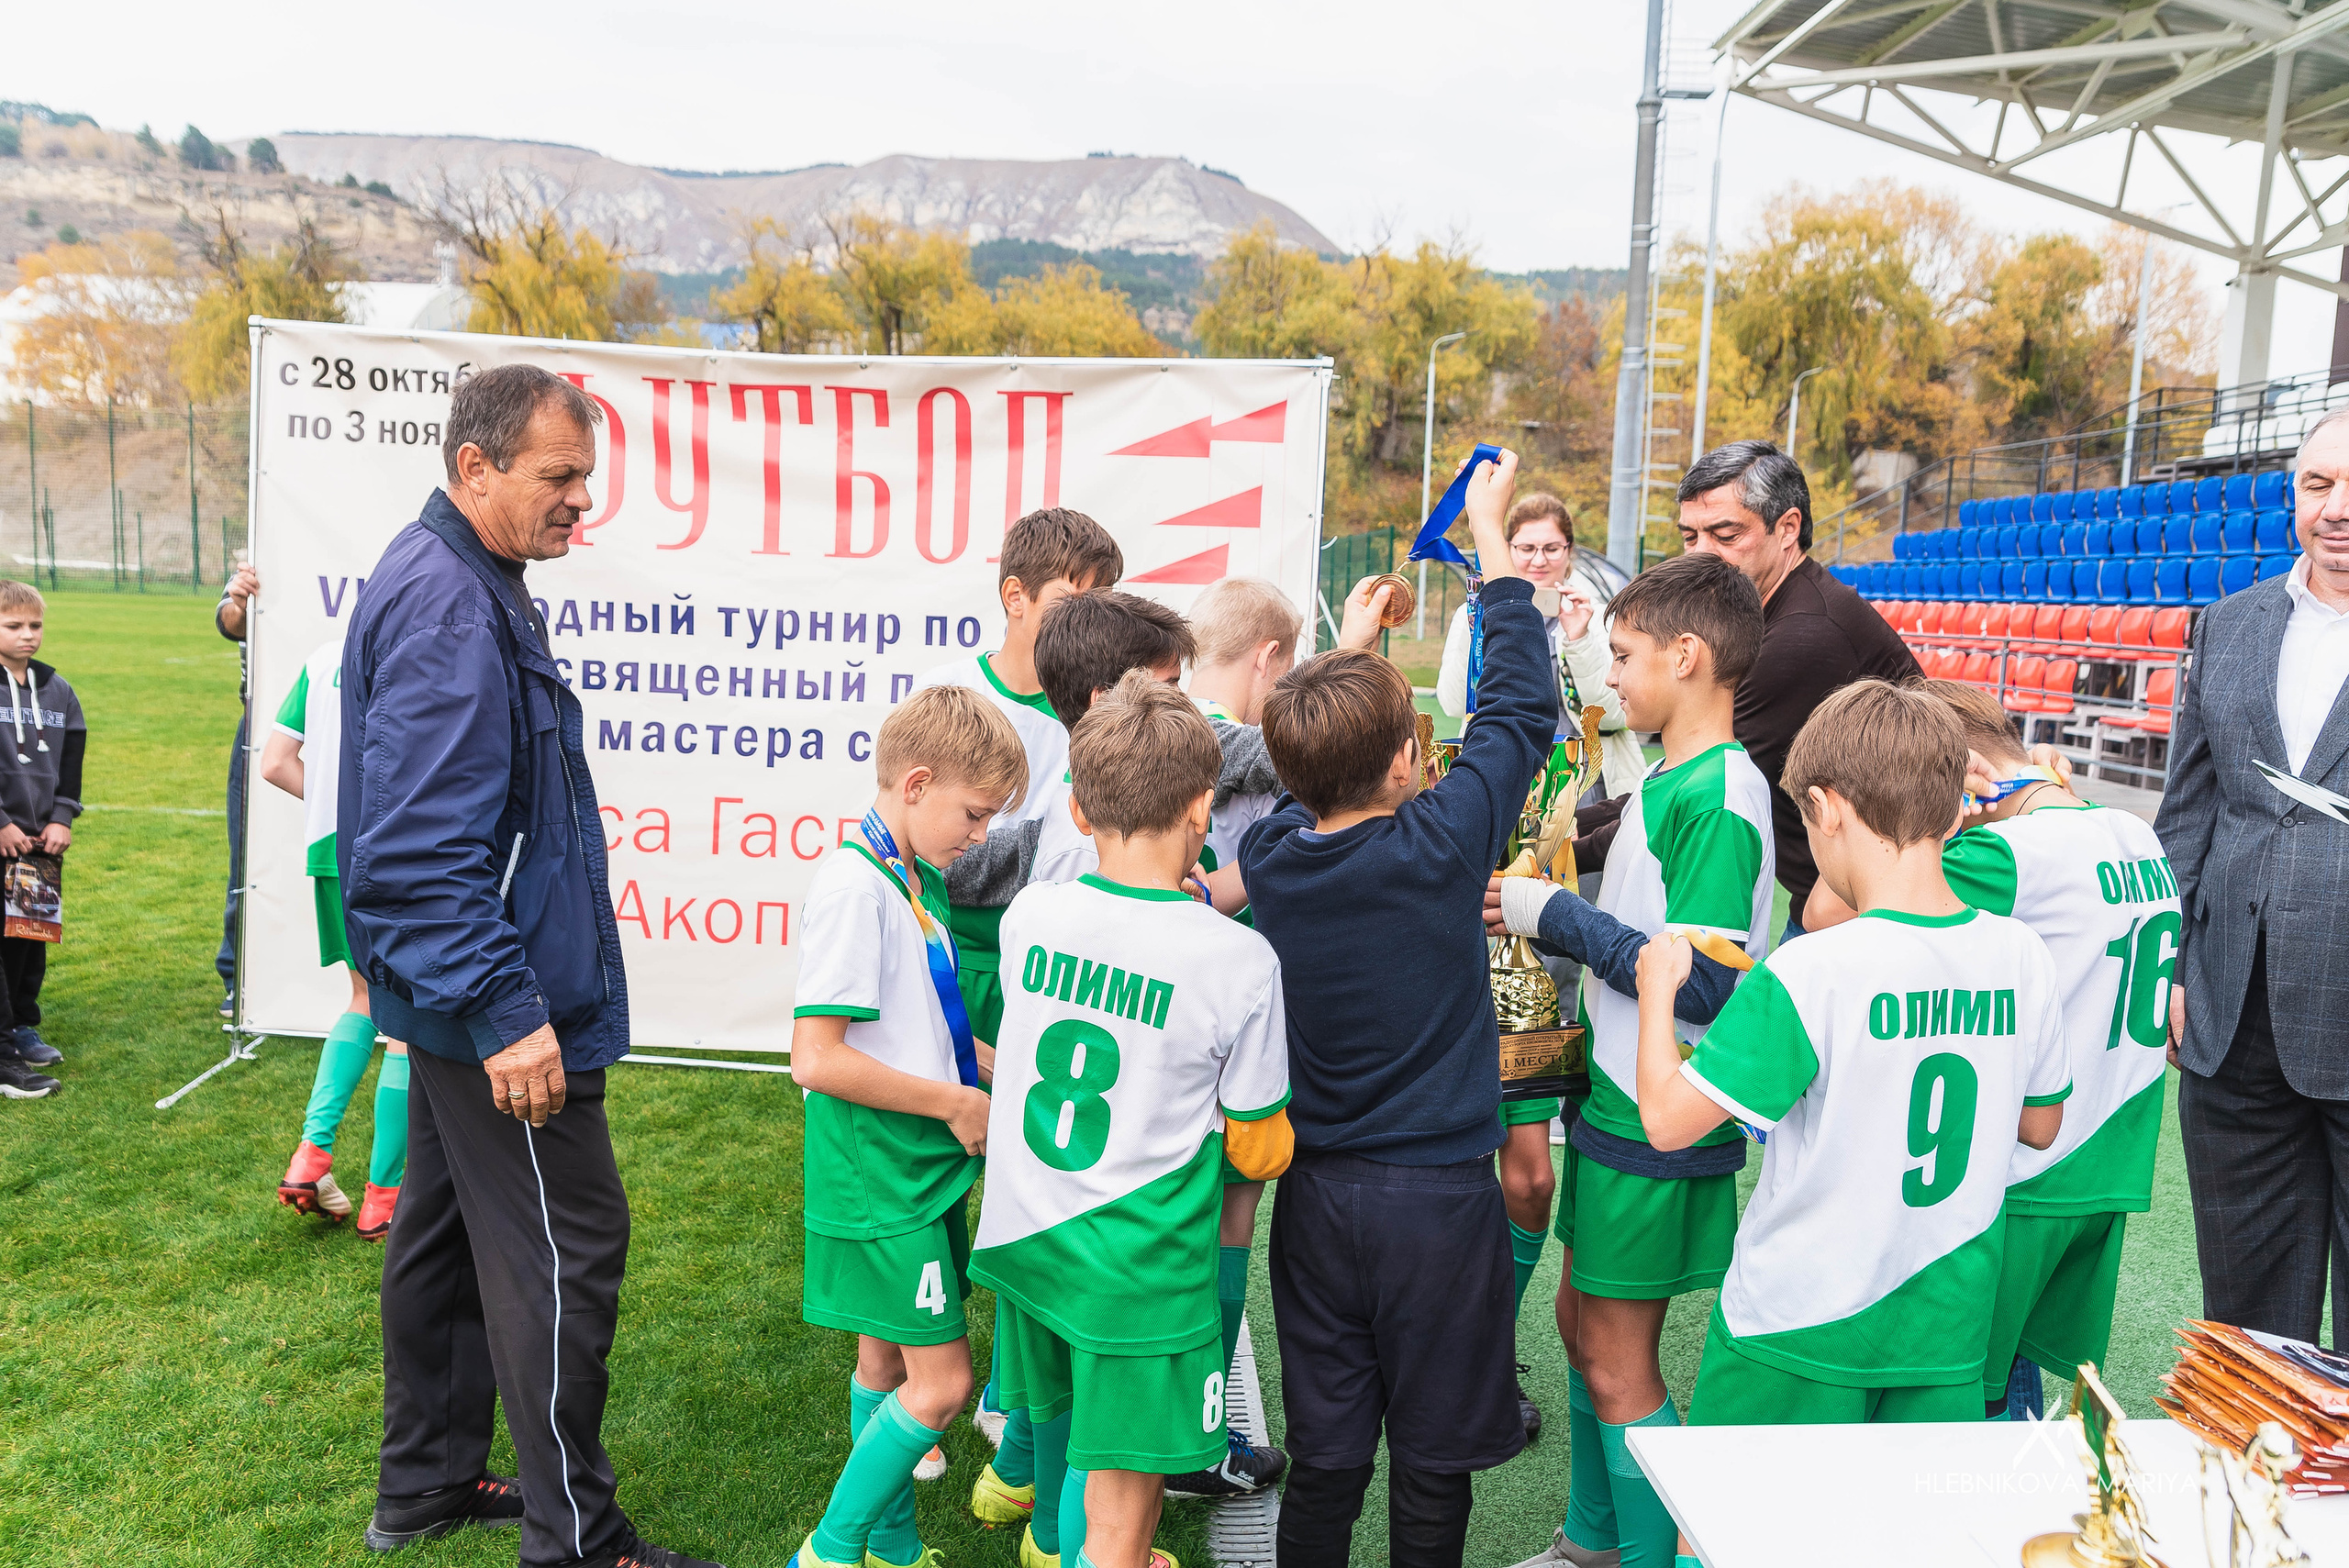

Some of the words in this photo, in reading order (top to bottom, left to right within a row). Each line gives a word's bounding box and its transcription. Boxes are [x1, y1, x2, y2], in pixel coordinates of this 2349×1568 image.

[280, 362, 299, 385] с
[311, 356, 356, 390] 28
[288, 414, 332, 439] по
[345, 410, 365, 442] 3
[378, 419, 441, 446] ноя
[718, 606, 901, 654] турнир
[925, 616, 981, 648] по
[555, 660, 866, 703] священный
[598, 717, 824, 768] мастера
[616, 879, 789, 946] Акоп
[1021, 944, 1175, 1030] ОЛИМП
[2105, 910, 2183, 1052] 16
[1868, 988, 2017, 1040] ОЛИМП
[1514, 1053, 1568, 1068] МЕСТО
[1023, 1018, 1121, 1173] 8
[1901, 1051, 1978, 1208] 9
[915, 1260, 947, 1317] 4
[1202, 1370, 1225, 1434] 8
